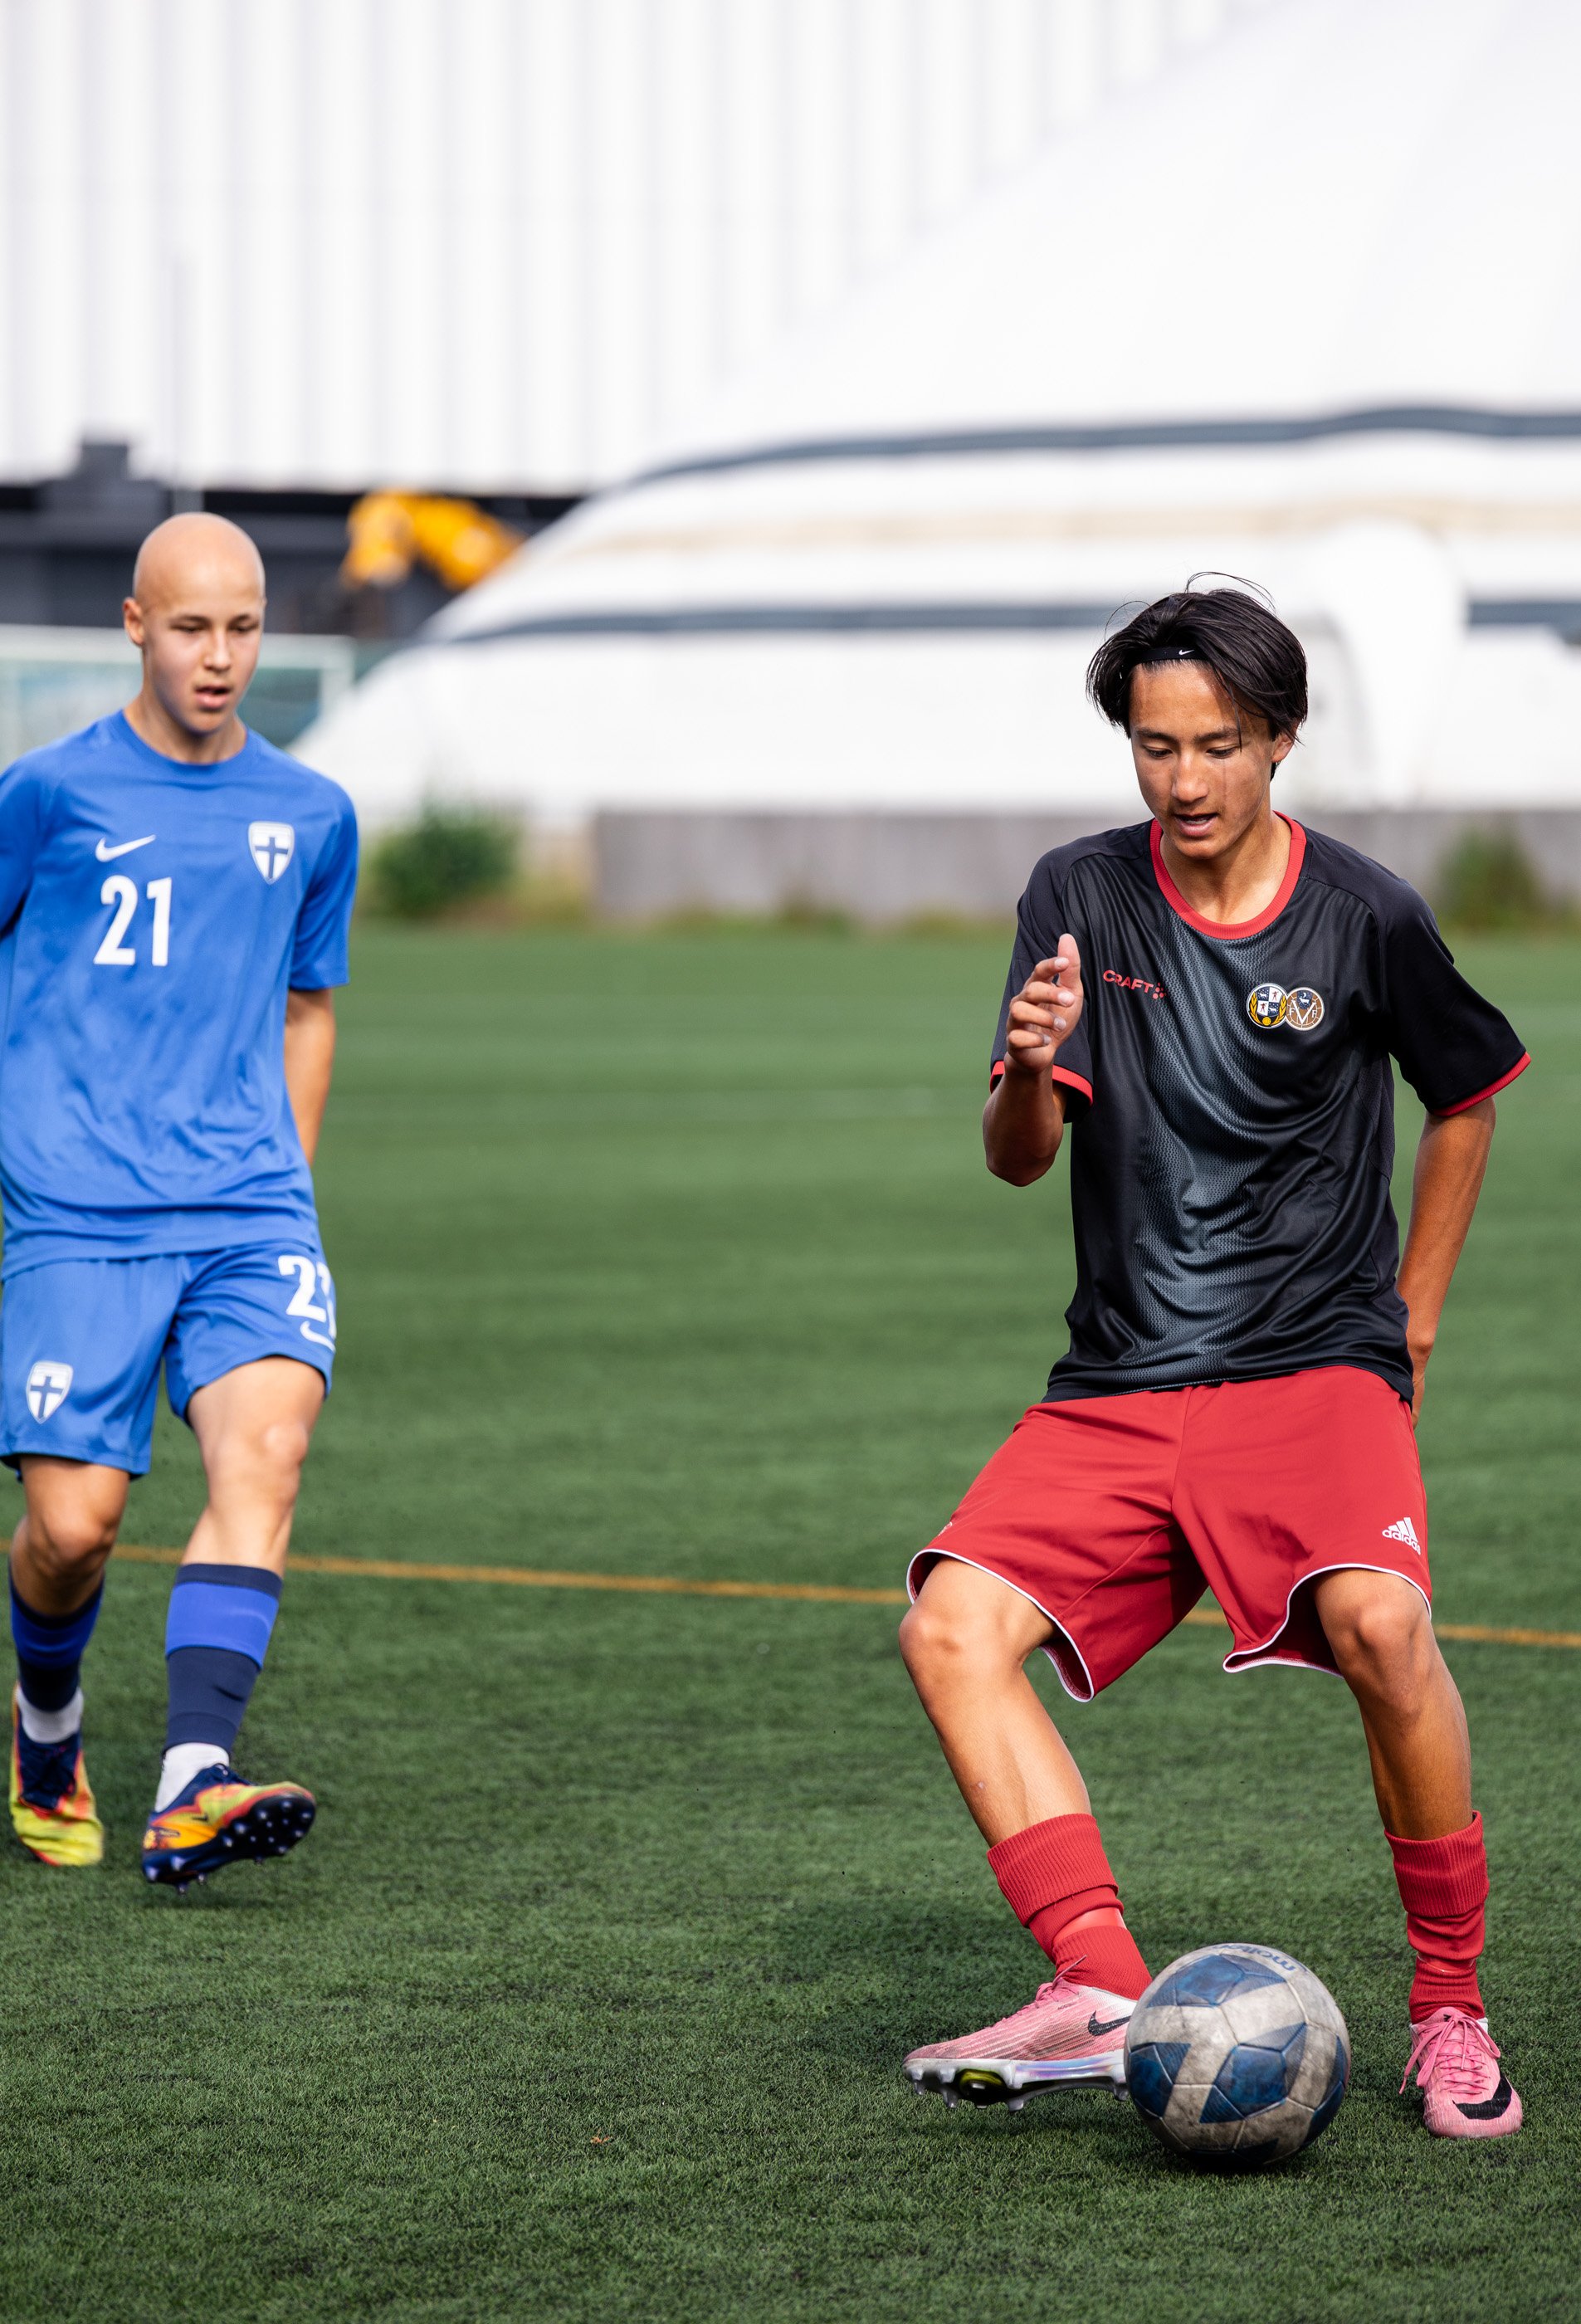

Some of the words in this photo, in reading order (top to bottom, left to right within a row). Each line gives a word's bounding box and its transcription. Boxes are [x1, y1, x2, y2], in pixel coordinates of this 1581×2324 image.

[93, 875, 172, 966] 21
[1103, 969, 1154, 993] CRAFT
[1382, 1529, 1421, 1555] adidas
